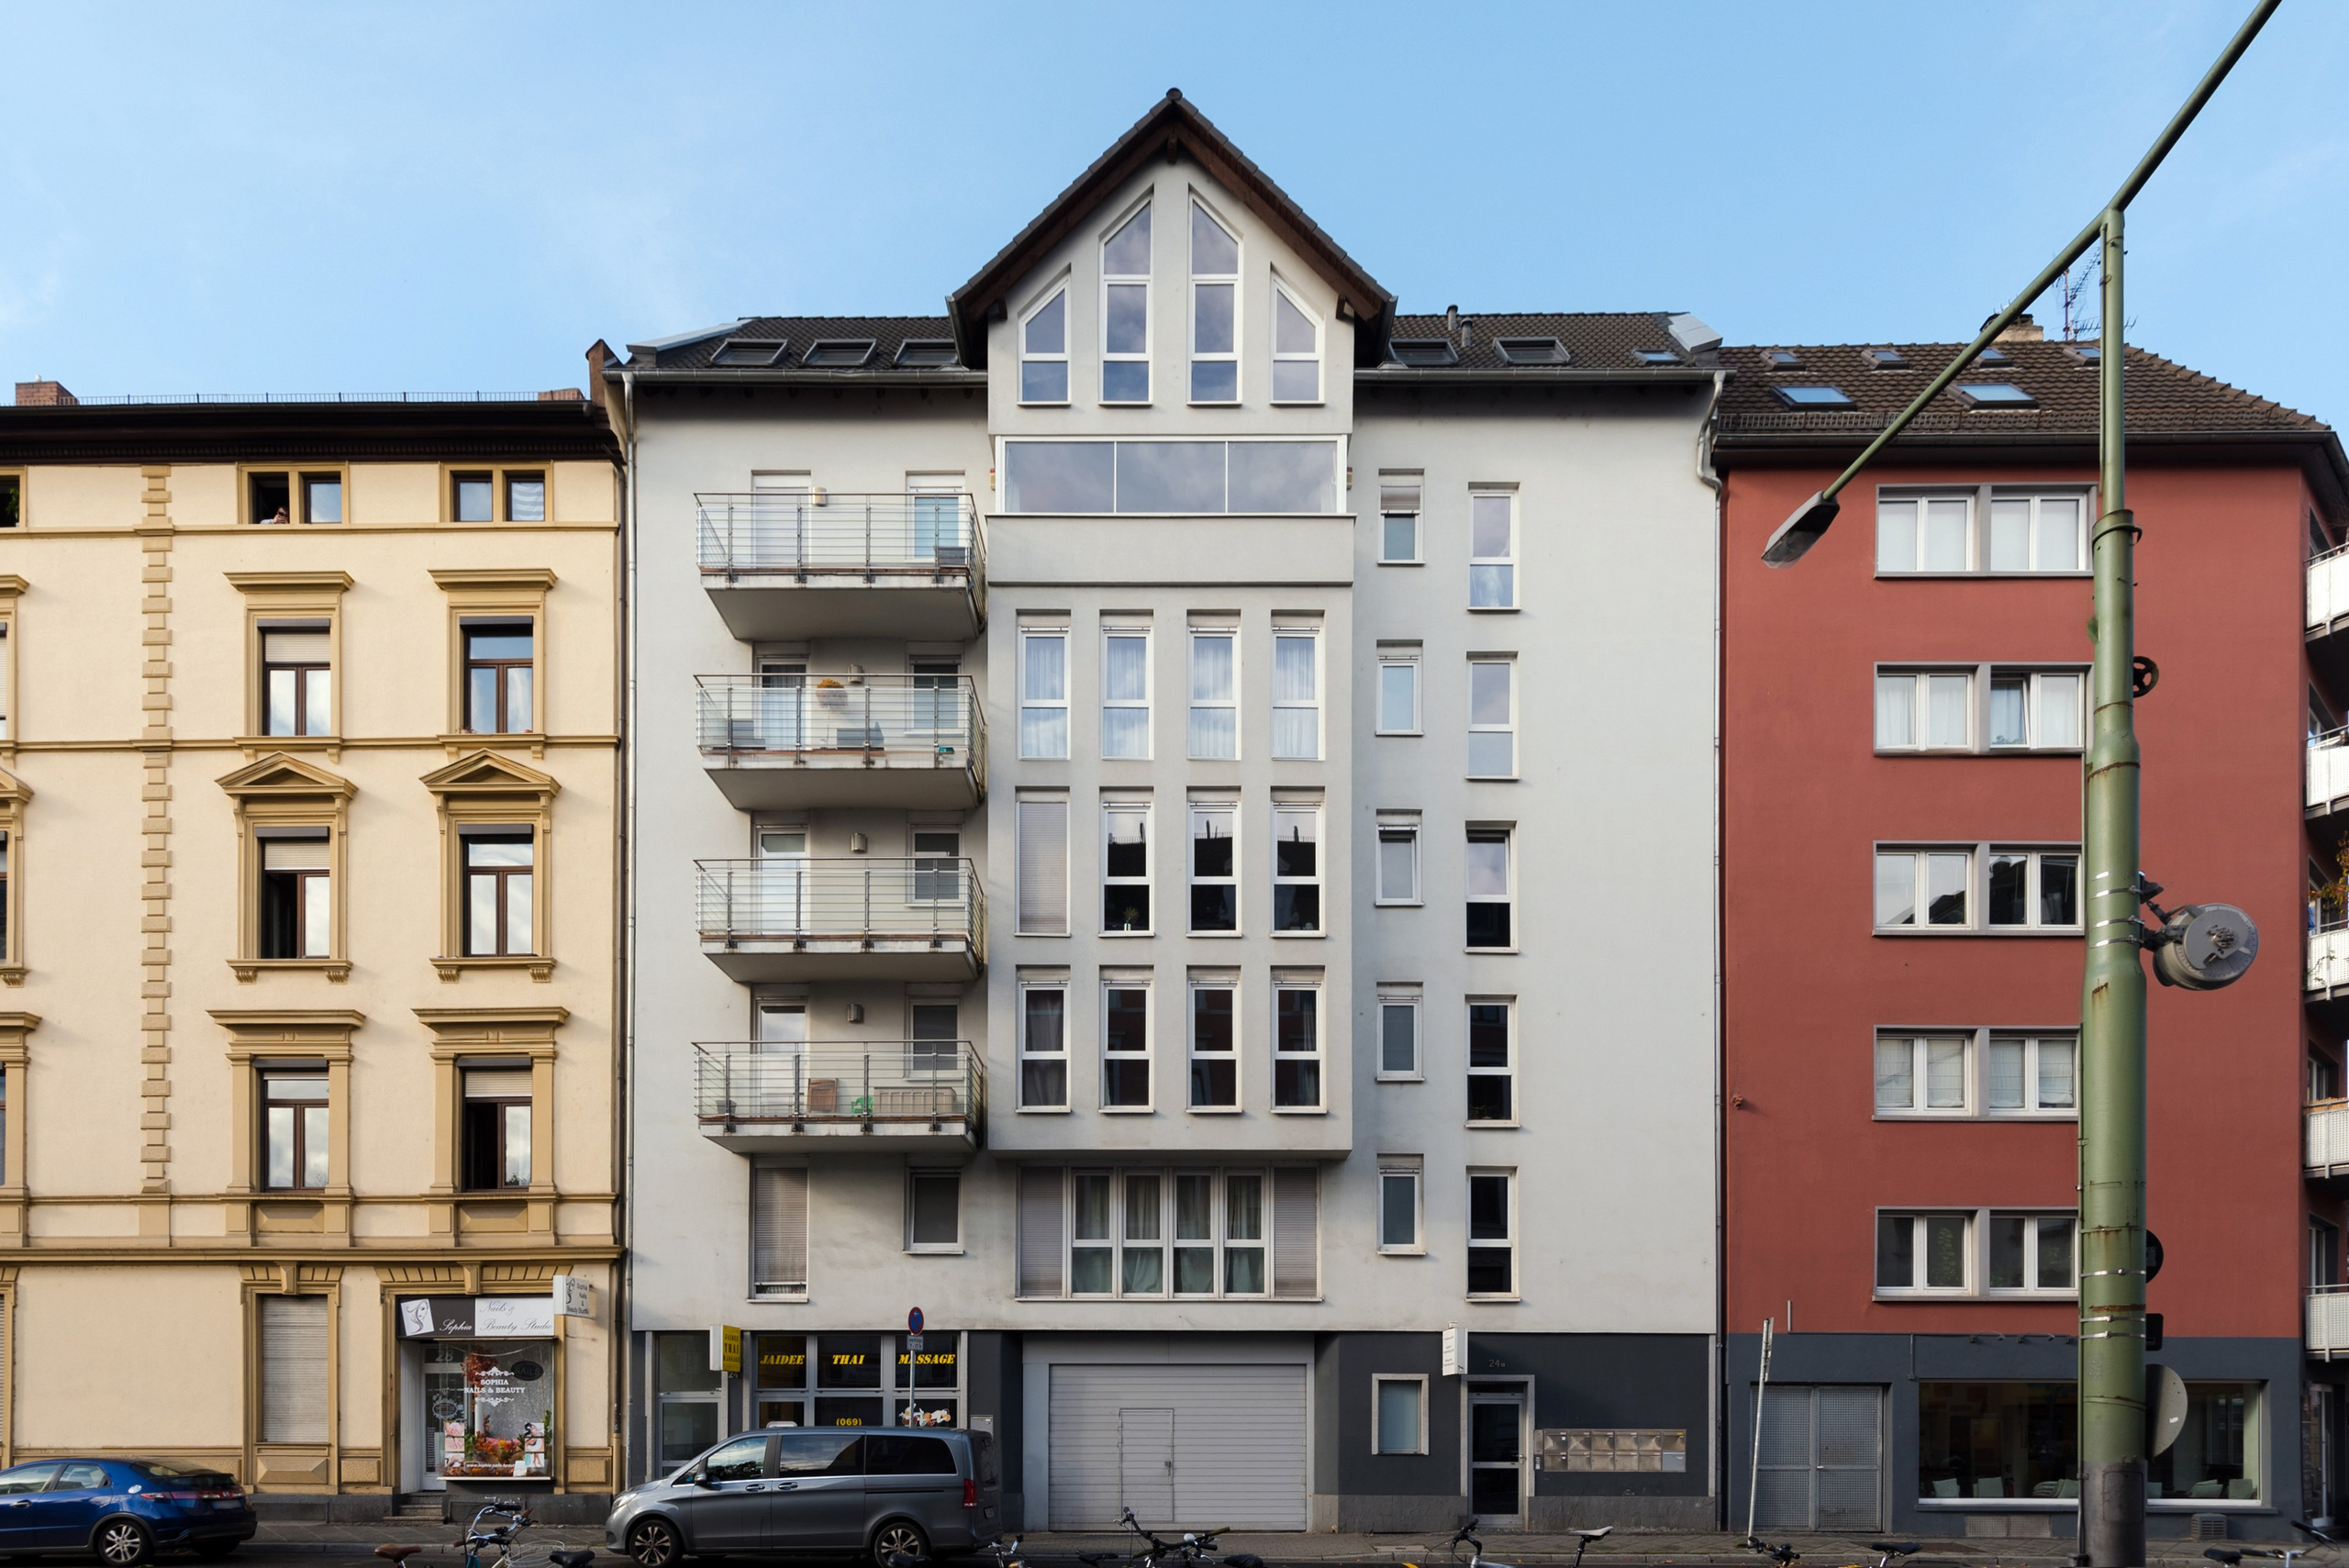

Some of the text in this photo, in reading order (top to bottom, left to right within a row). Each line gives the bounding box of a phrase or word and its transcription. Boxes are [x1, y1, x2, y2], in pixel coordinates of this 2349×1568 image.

[479, 1300, 515, 1315] Nails &
[439, 1318, 473, 1334] Sophia
[480, 1318, 552, 1333] Beauty Studio
[724, 1342, 739, 1354] THAI
[435, 1349, 454, 1362] 28
[760, 1354, 805, 1365] JAIDEE
[832, 1354, 864, 1365] THAI
[1488, 1359, 1506, 1368] 24a
[514, 1365, 541, 1377] NAILS
[836, 1418, 863, 1427] (069)
